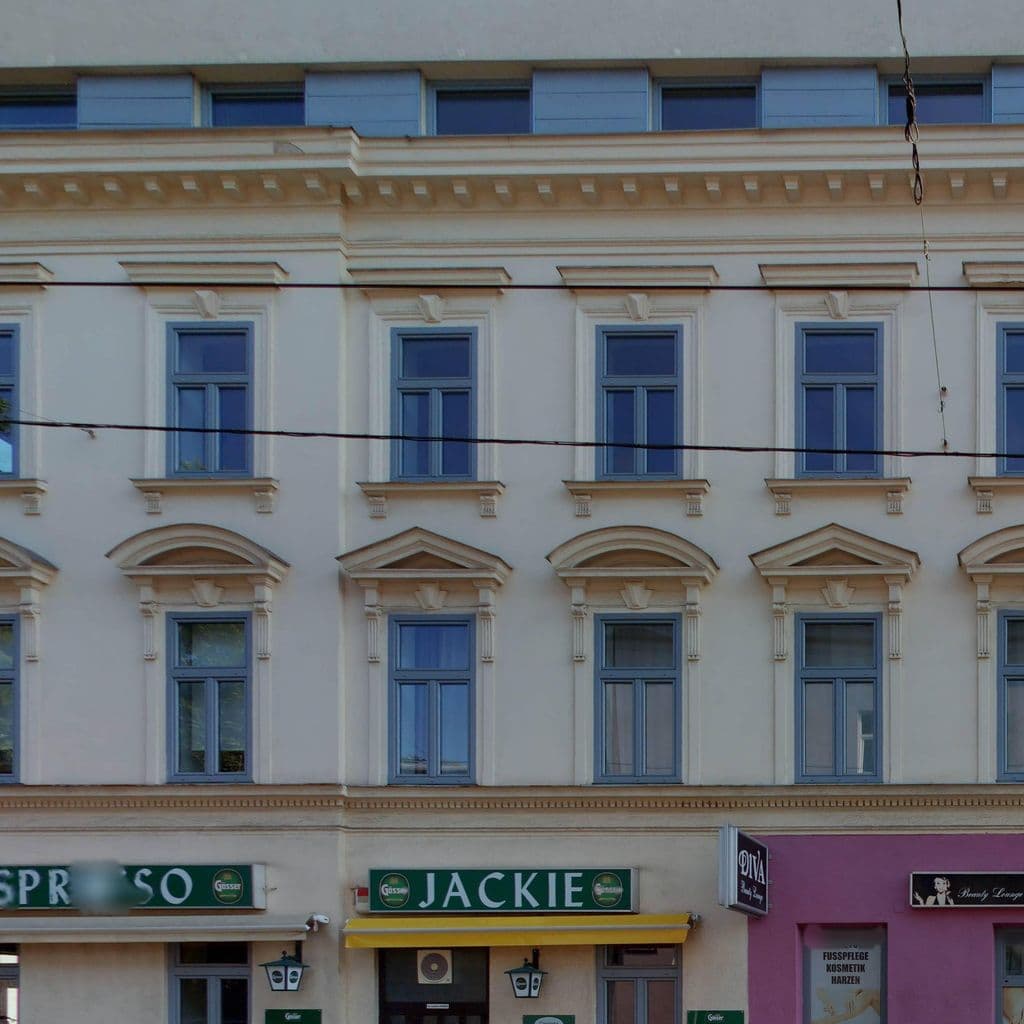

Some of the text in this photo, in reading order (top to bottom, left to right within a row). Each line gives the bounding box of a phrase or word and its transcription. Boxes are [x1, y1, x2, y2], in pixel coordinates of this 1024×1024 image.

[738, 849, 766, 885] DIVA
[418, 872, 583, 908] JACKIE
[823, 951, 869, 961] FUSSPFLEGE
[826, 964, 866, 973] KOSMETIK
[831, 976, 861, 985] HARZEN
